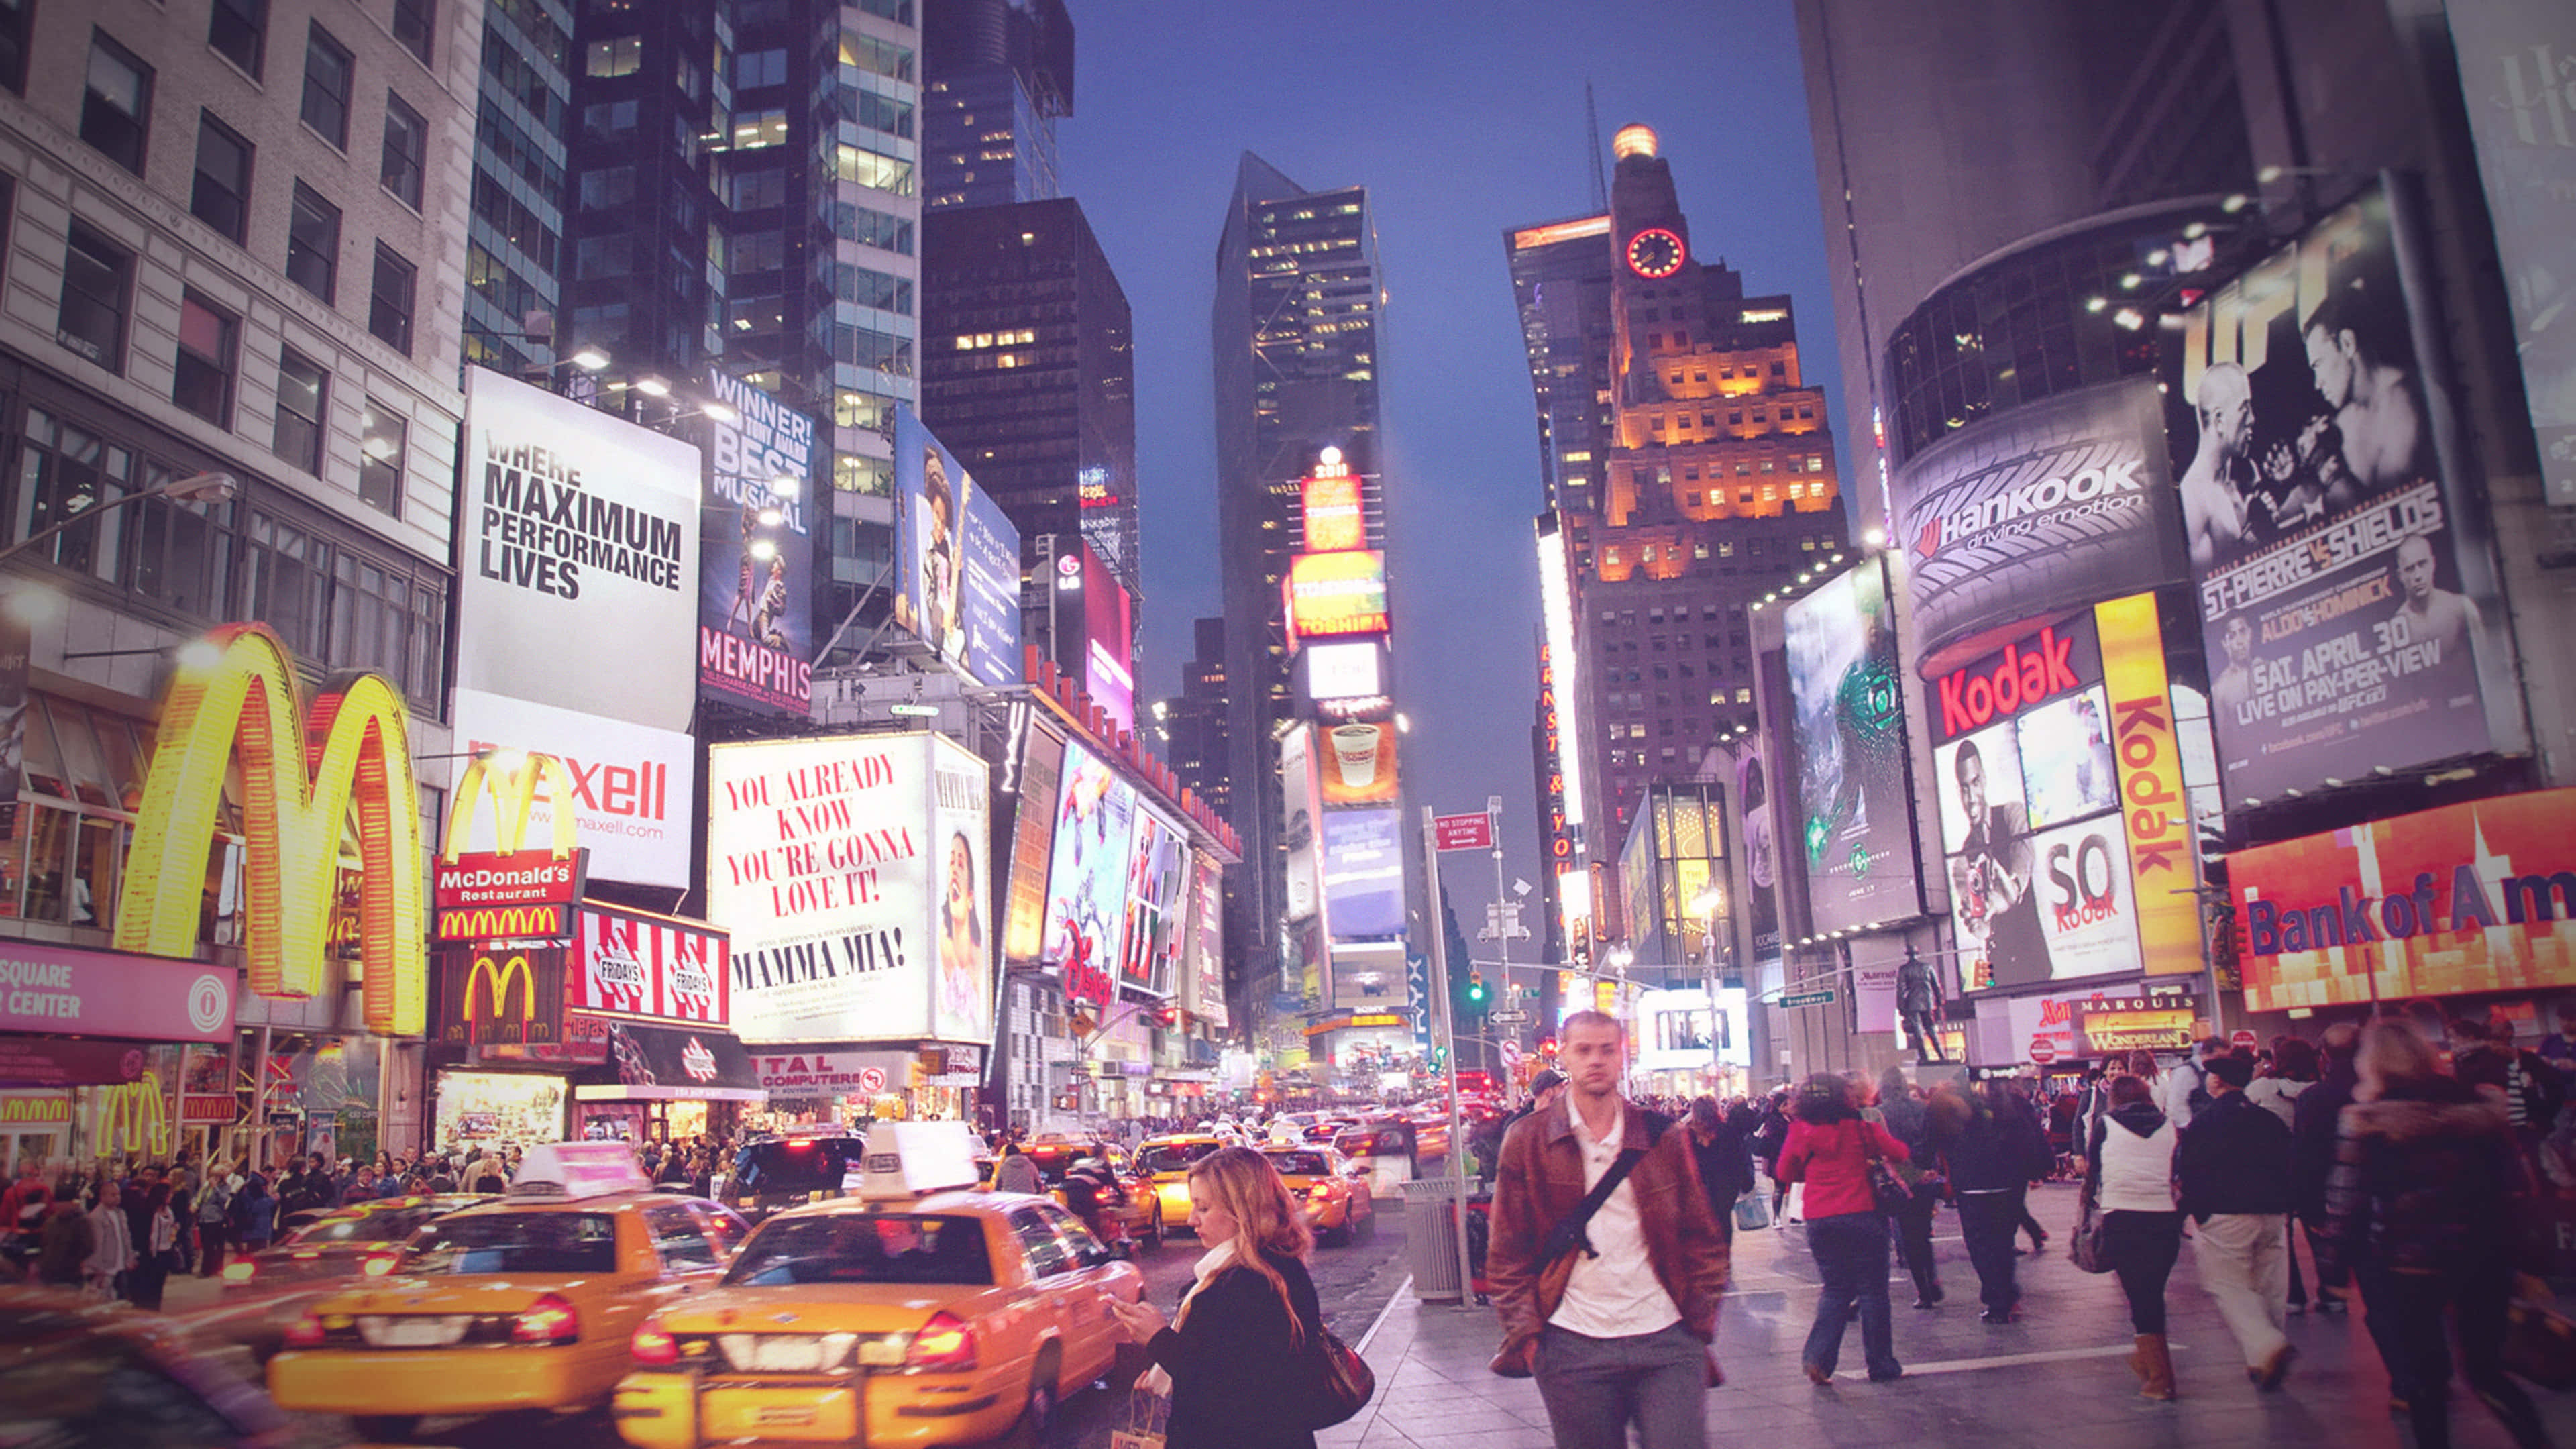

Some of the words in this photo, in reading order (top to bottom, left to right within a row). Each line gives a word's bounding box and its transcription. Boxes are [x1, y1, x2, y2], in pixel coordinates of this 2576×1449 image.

[711, 368, 812, 446] WINNER!
[746, 416, 772, 445] TONY
[486, 429, 581, 488] WHERE
[714, 422, 807, 504] BEST
[1315, 463, 1347, 478] 2011
[484, 462, 682, 562] MAXIMUM
[1967, 519, 2032, 550] driving
[2037, 494, 2145, 527] emotion
[2330, 490, 2443, 564] SHIELDS
[480, 539, 579, 600] LIVES
[482, 506, 679, 591] PERFORMANCE
[1058, 576, 1080, 590] LG
[1298, 615, 1389, 635] TOSHIBA
[2261, 608, 2303, 644] ALDO
[2302, 631, 2371, 680] APRIL
[2373, 616, 2410, 654] 30
[701, 625, 811, 701] MEMPHIS
[1939, 627, 2078, 737] Kodak
[2237, 696, 2276, 726] LIVE
[2277, 684, 2304, 713] ON
[2304, 638, 2442, 704] PAY-PER-VIEW
[1541, 644, 1558, 753] ERNST
[726, 773, 777, 812] YOU
[786, 753, 894, 802] ALREADY
[2114, 694, 2184, 876] Kodak
[777, 798, 853, 841] KNOW
[440, 864, 570, 889] McDonald's
[727, 842, 820, 886] YOU'RE
[828, 826, 915, 871] GONNA
[2047, 833, 2118, 915] SO
[460, 887, 547, 902] Restaurant
[772, 877, 839, 918] LOVE
[847, 867, 880, 906] IT!
[2055, 890, 2119, 934] Kodak
[2247, 884, 2377, 957] Bank
[2381, 871, 2438, 939] of
[0, 959, 72, 989] SQUARE
[732, 941, 837, 993] MAMMA
[843, 926, 905, 976] MIA!
[9, 991, 80, 1018] CENTER
[2082, 997, 2194, 1011] MARQUIS
[2086, 1030, 2193, 1051] WONDERLAND
[763, 1073, 860, 1087] COMPUTERS
